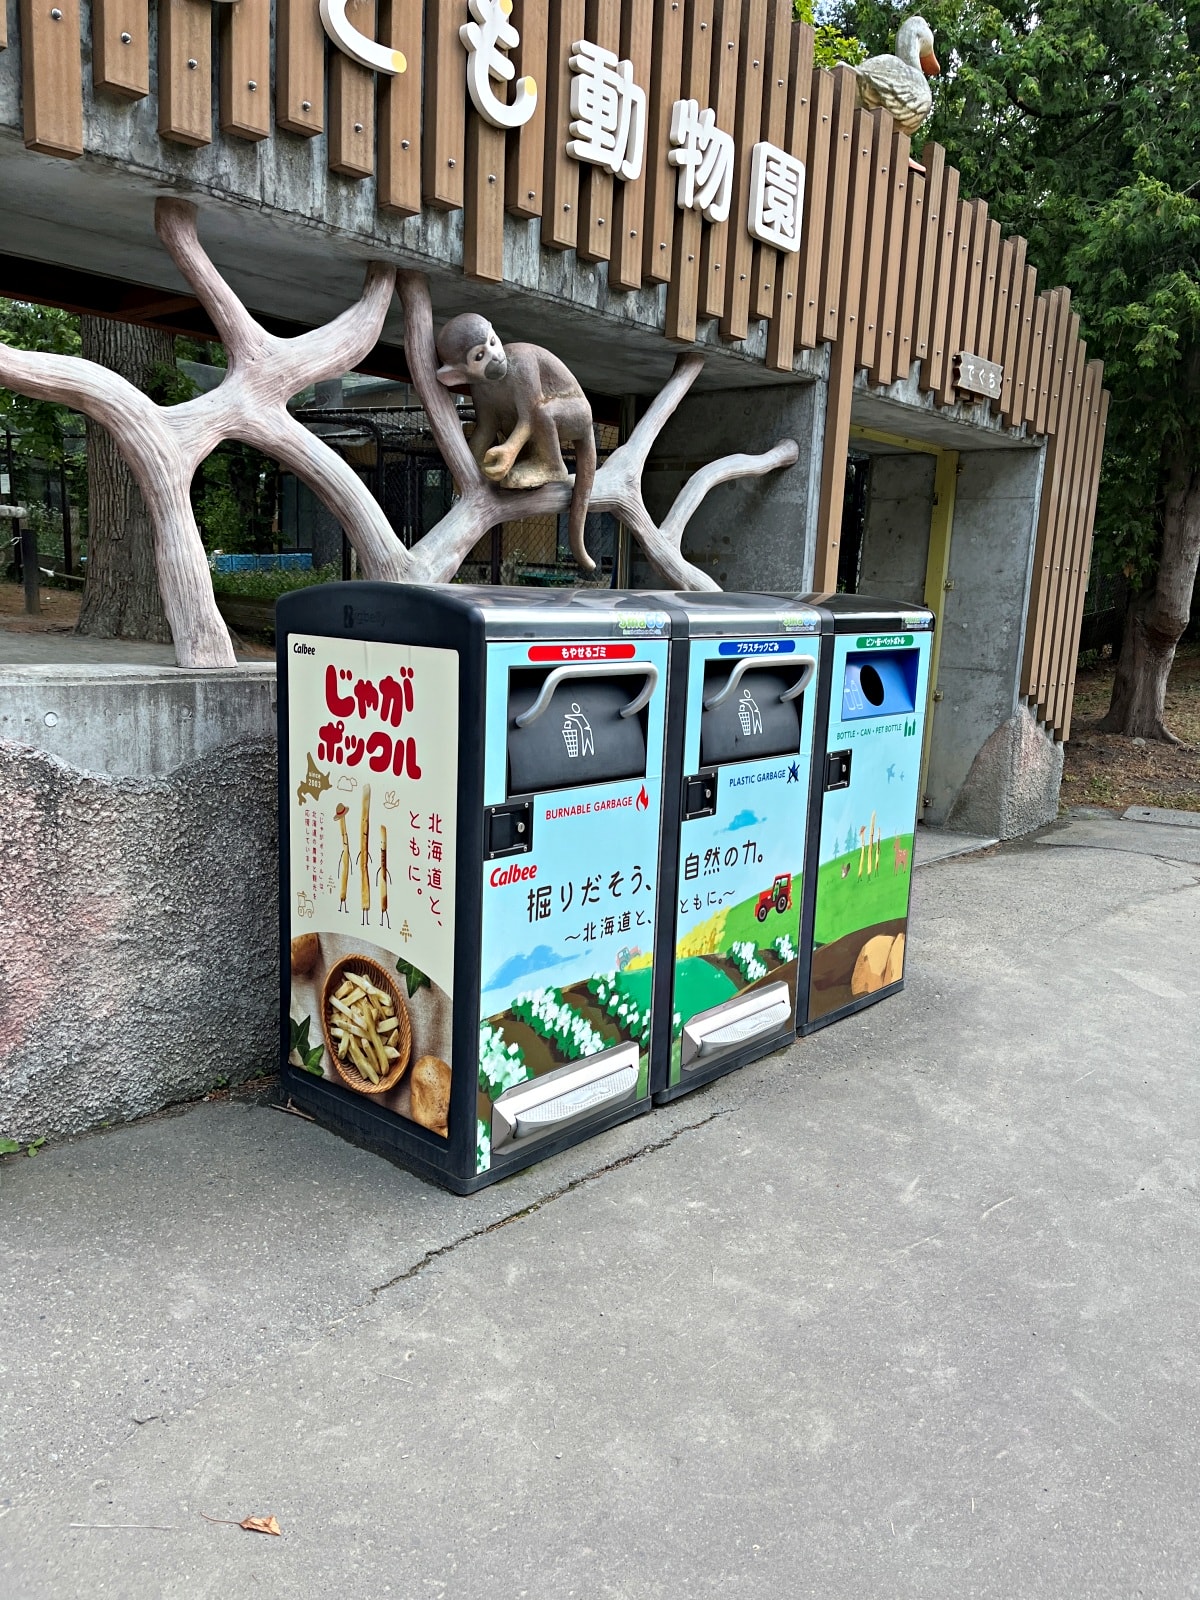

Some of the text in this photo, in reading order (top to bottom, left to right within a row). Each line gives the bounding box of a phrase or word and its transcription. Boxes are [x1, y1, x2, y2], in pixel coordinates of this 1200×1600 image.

[967, 364, 996, 389] でぐち
[293, 643, 316, 656] Calbee
[561, 646, 607, 659] もやせるゴミ
[737, 642, 779, 653] プラスチックごみ
[325, 664, 414, 727] じゃが
[836, 723, 902, 740] BOTTLE CAN PET BOTTLE
[317, 720, 422, 780] ポックル
[729, 769, 786, 788] PLASTIC GARBAGE
[545, 796, 633, 820] BURNABLE GARBAGE
[408, 810, 423, 895] ともに。
[685, 839, 763, 881] 自然の力。
[489, 863, 538, 888] Calbee
